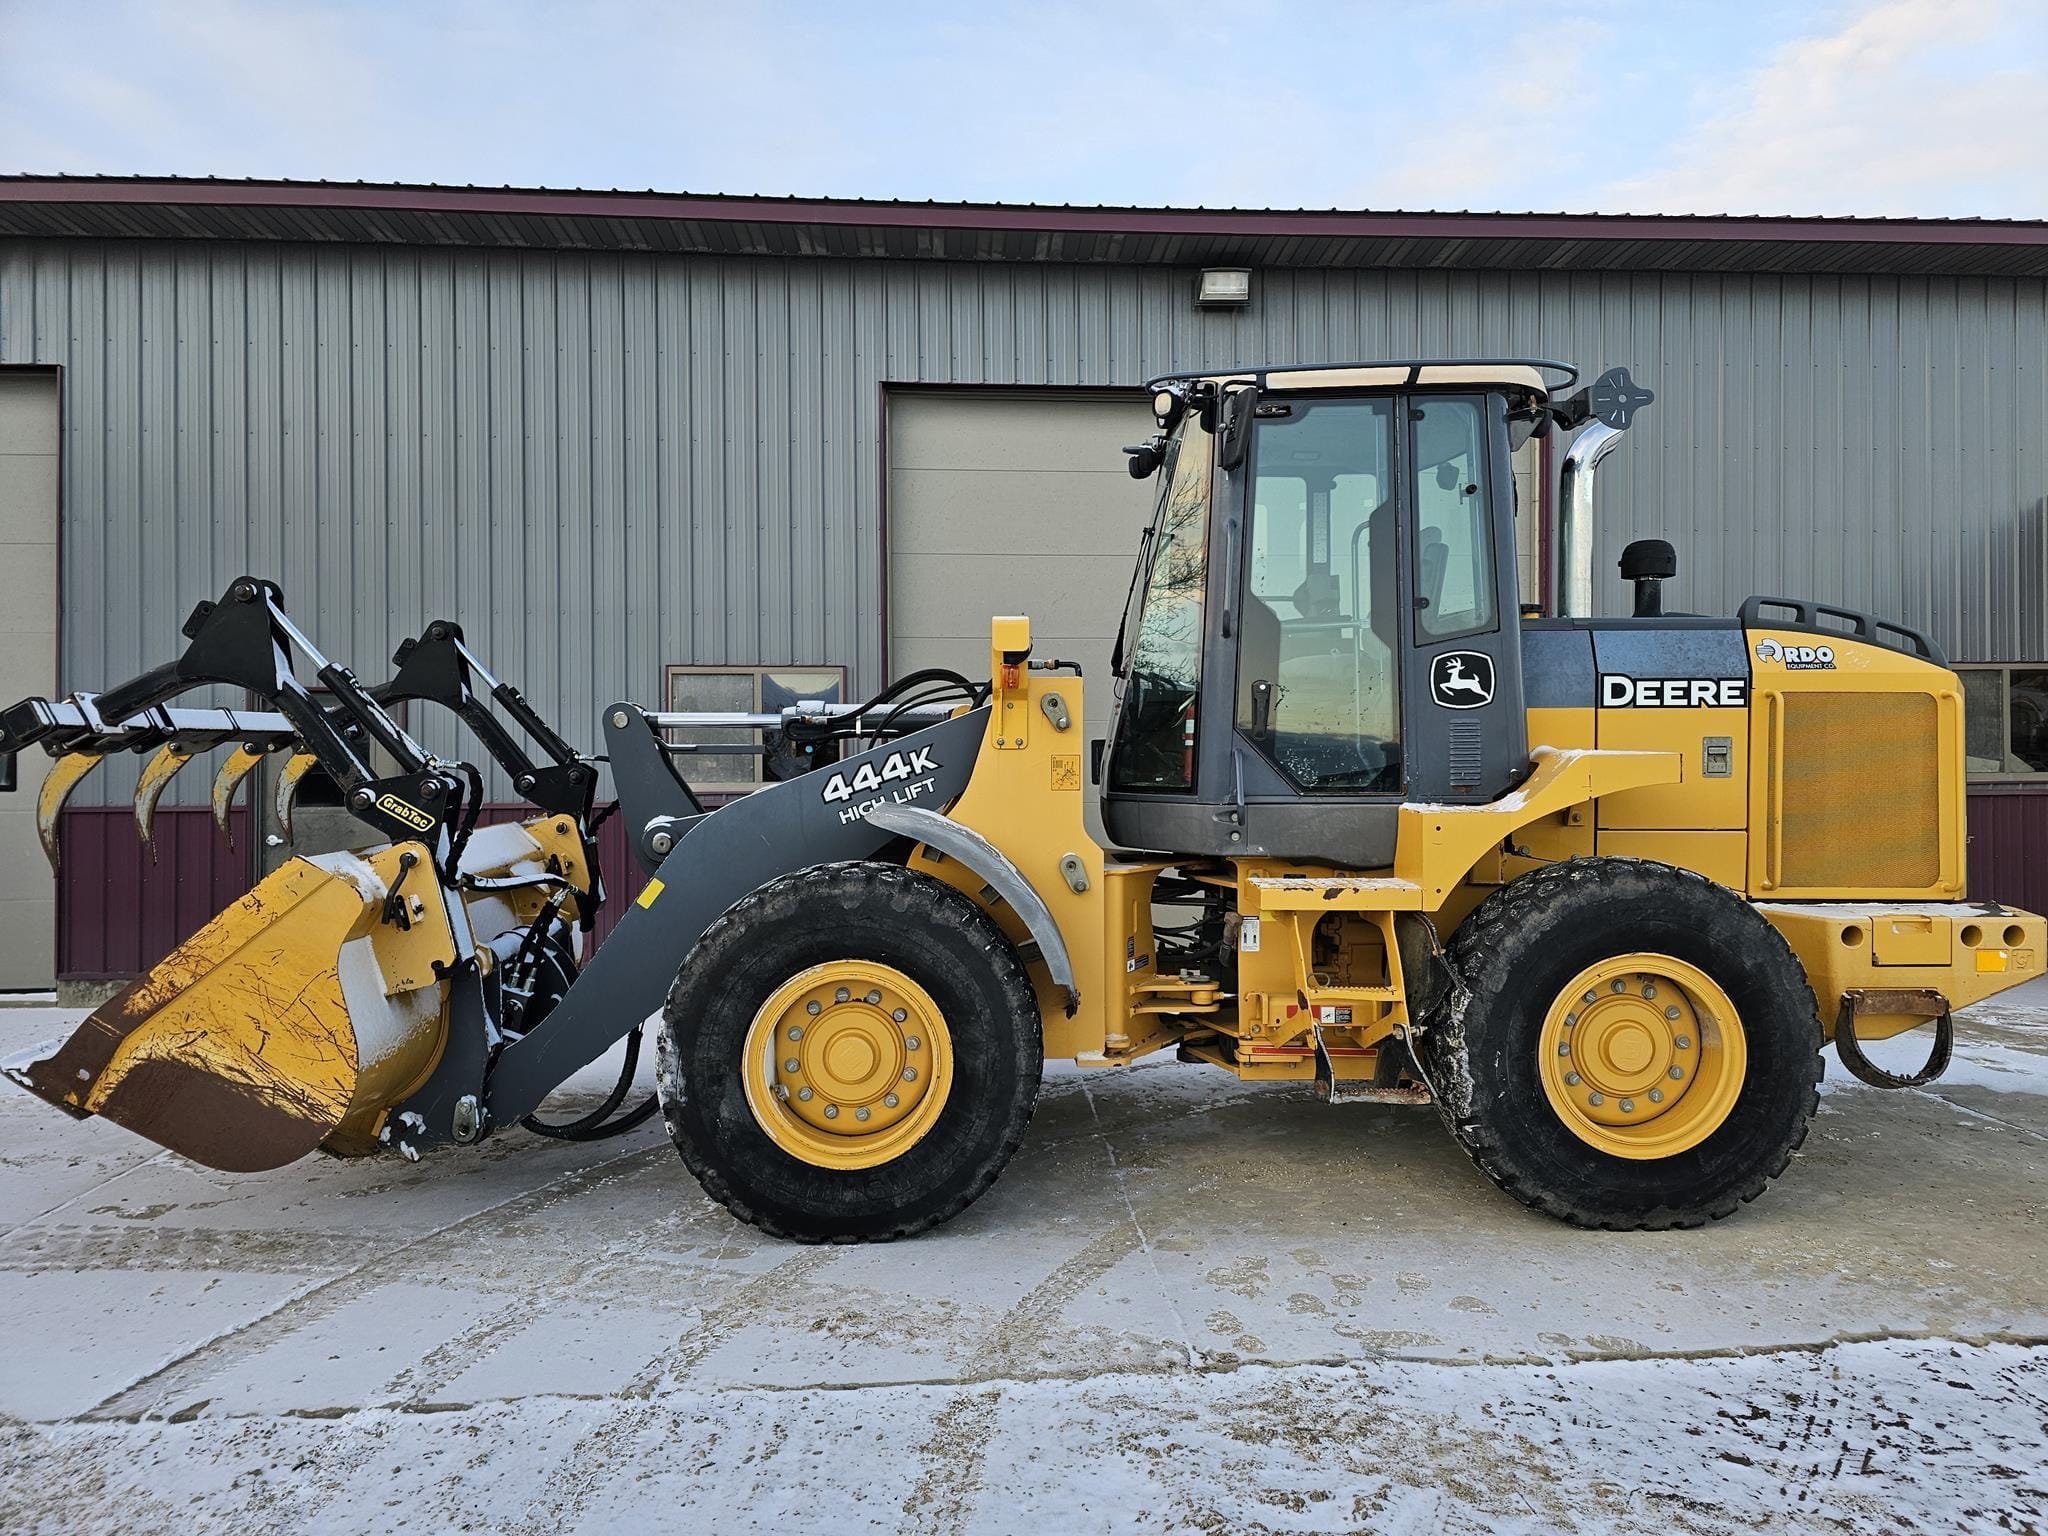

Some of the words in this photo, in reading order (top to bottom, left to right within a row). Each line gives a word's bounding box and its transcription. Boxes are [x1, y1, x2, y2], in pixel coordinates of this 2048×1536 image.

[1784, 646, 1834, 663] RDO
[1602, 675, 1745, 706] DEERE
[822, 745, 940, 803] 444K
[892, 777, 936, 805] LIFT
[383, 797, 428, 828] GrabTec
